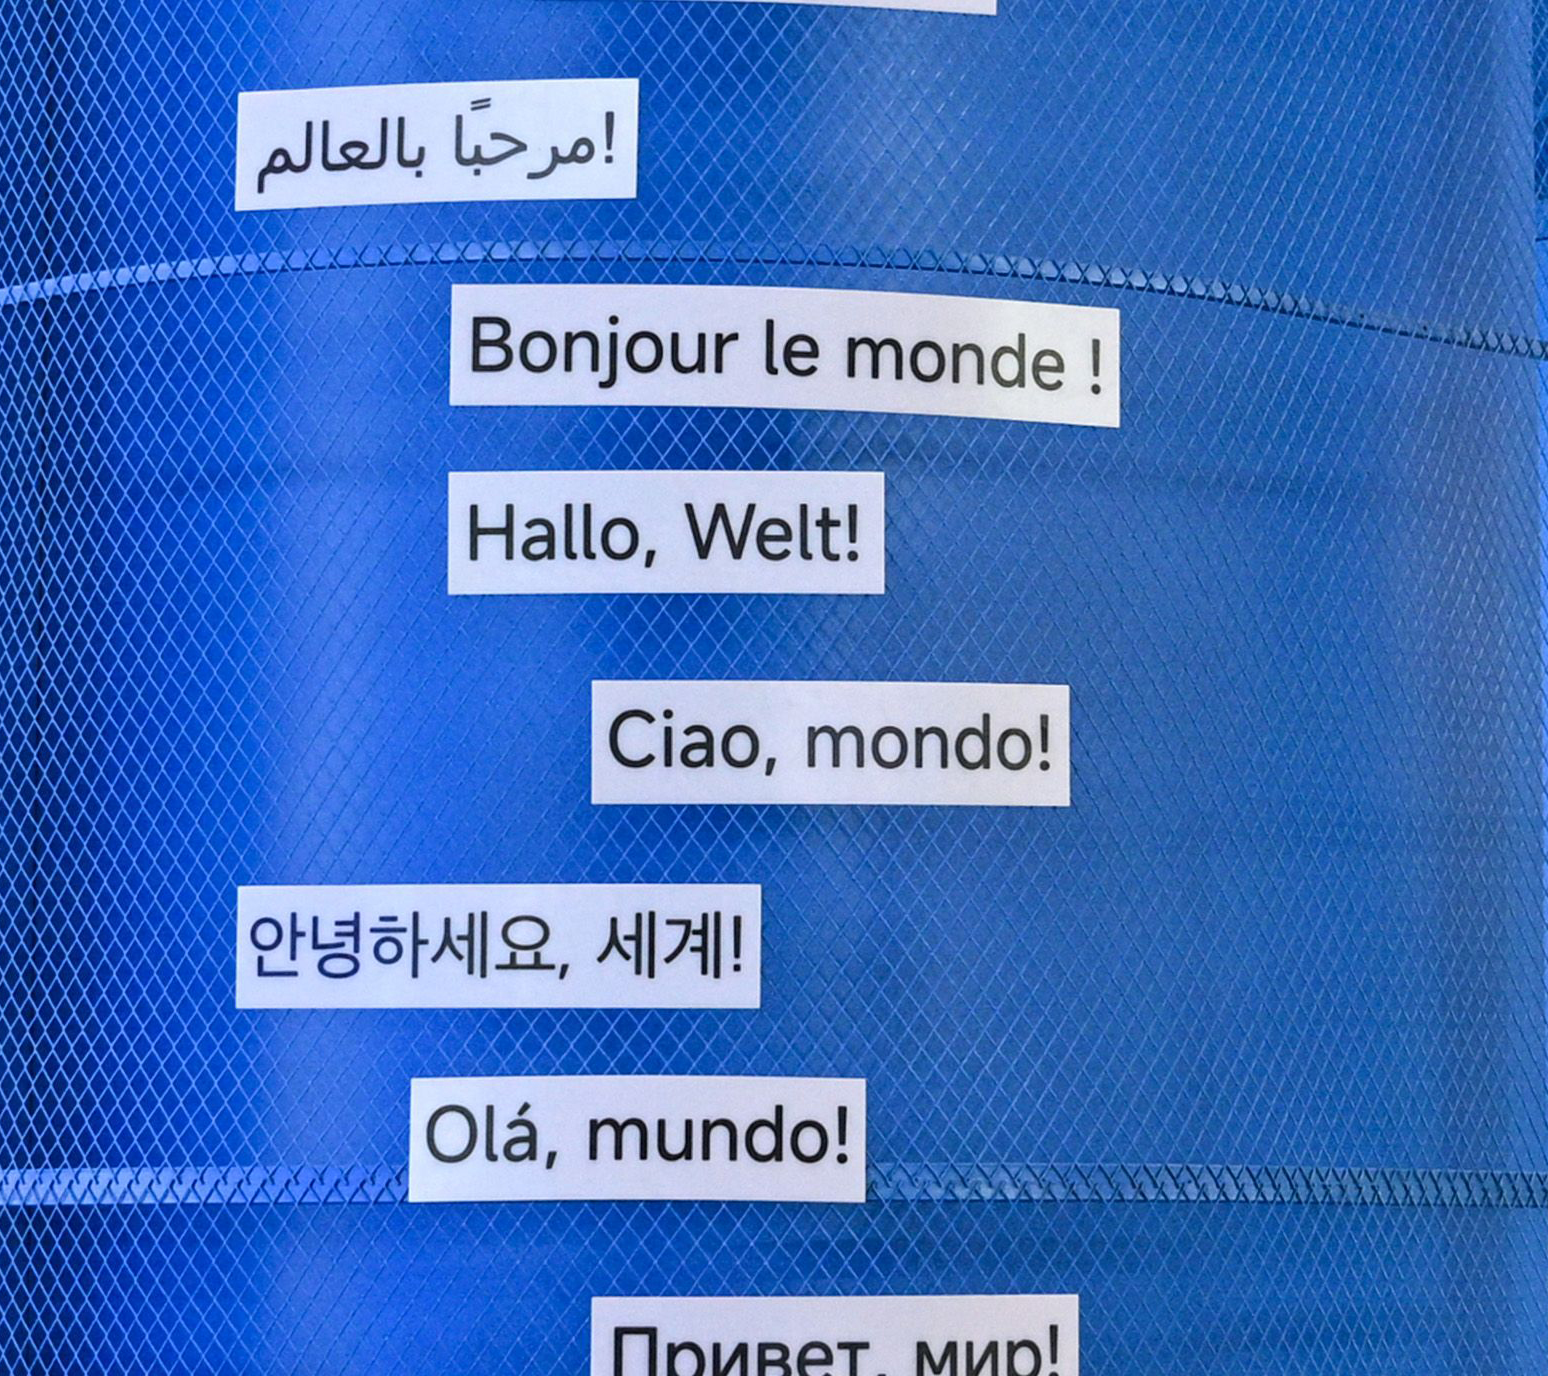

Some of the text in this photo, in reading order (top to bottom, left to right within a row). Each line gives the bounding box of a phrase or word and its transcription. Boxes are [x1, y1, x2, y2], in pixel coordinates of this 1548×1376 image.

[470, 315, 1104, 395] Bonjour le monde !
[468, 502, 860, 568] Hallo, Welt!
[608, 709, 1052, 776] Ciao, mondo!
[250, 911, 745, 979] 안녕하세요, 세계!
[424, 1102, 850, 1169] Olá, mundo!
